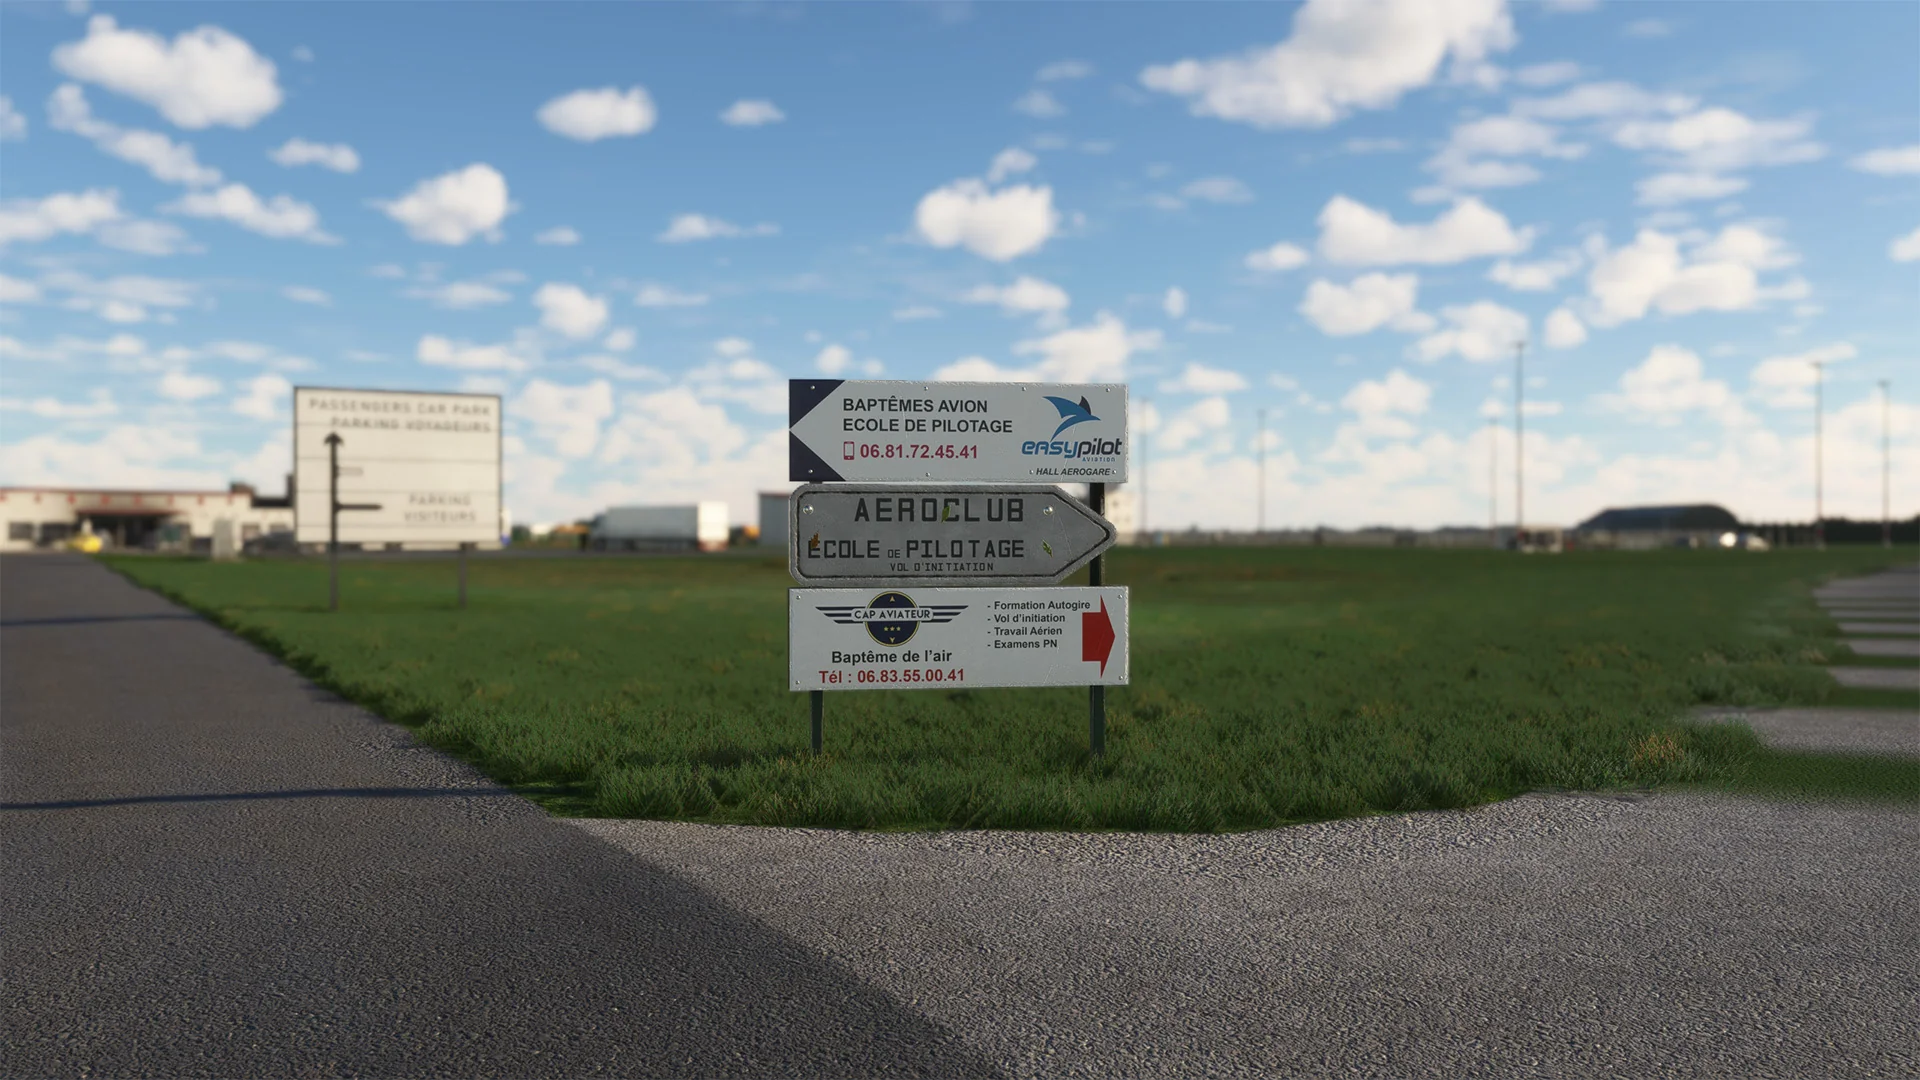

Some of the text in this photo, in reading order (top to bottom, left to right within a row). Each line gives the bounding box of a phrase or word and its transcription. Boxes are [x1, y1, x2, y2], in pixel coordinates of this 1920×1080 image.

[309, 399, 490, 416] PASSENGERS CAR PARK
[843, 396, 988, 413] BAPTÊMES AVION
[331, 417, 491, 433] PARKING VOYAGEURS
[843, 419, 1013, 433] ECOLE DE PILOTAGE
[860, 444, 978, 459] 06.81.72.45.41
[409, 495, 471, 505] PARKING
[404, 511, 476, 522] VISITEURS
[855, 498, 1024, 522] AEROCLUB
[888, 549, 901, 558] DE
[906, 540, 1024, 558] PILOTAGE
[890, 563, 910, 572] VOL
[994, 601, 1090, 611] Formation Autogire
[854, 609, 931, 619] CAP AVIATEUR
[994, 614, 1010, 623] Vol
[994, 626, 1062, 636] Travail Aérien
[994, 639, 1058, 649] Examens PN
[832, 650, 897, 666] Baptême
[902, 650, 919, 663] de
[819, 670, 842, 683] Tél
[857, 669, 964, 683] 06.83.55.00.41
